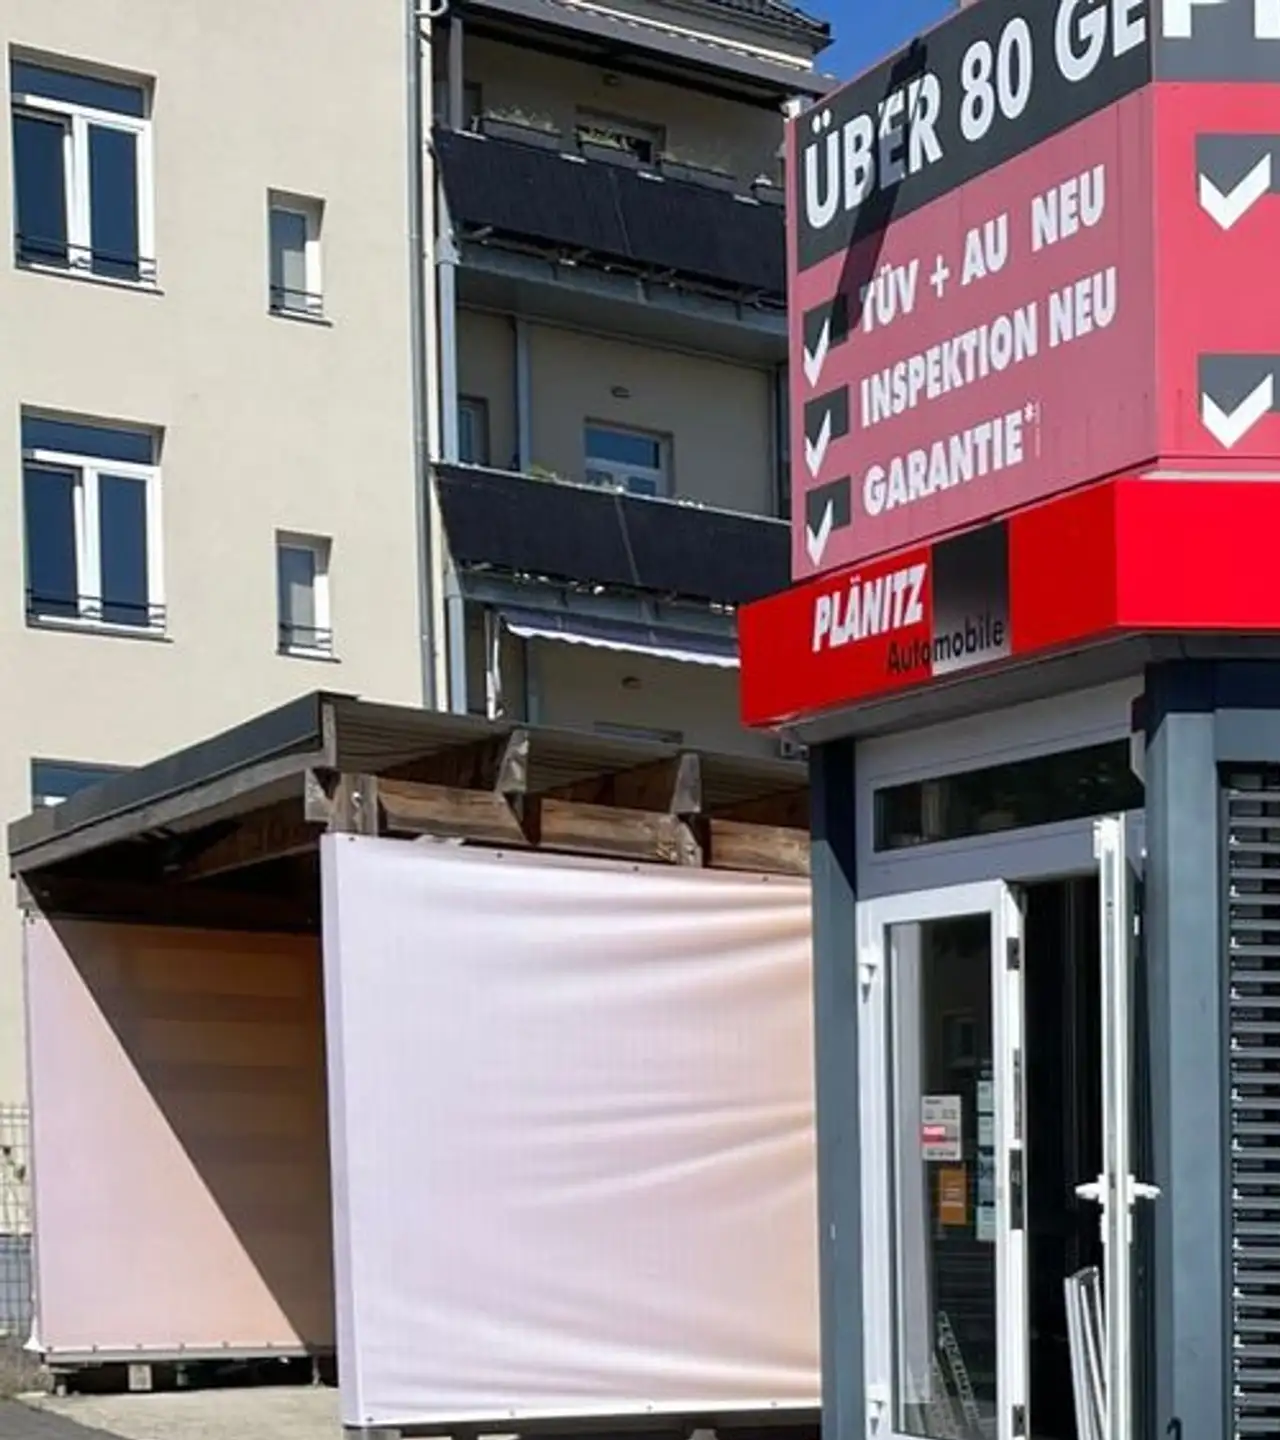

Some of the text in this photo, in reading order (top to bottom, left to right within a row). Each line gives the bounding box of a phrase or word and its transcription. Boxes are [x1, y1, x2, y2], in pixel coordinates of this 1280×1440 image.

[805, 72, 943, 229] ÜBER
[959, 16, 1032, 142] 80
[860, 164, 1105, 333] TÜV + AU NEU
[860, 267, 1117, 429] INSPEKTION NEU
[812, 562, 927, 653] PLÄNITZ
[887, 612, 1005, 674] Automobile
